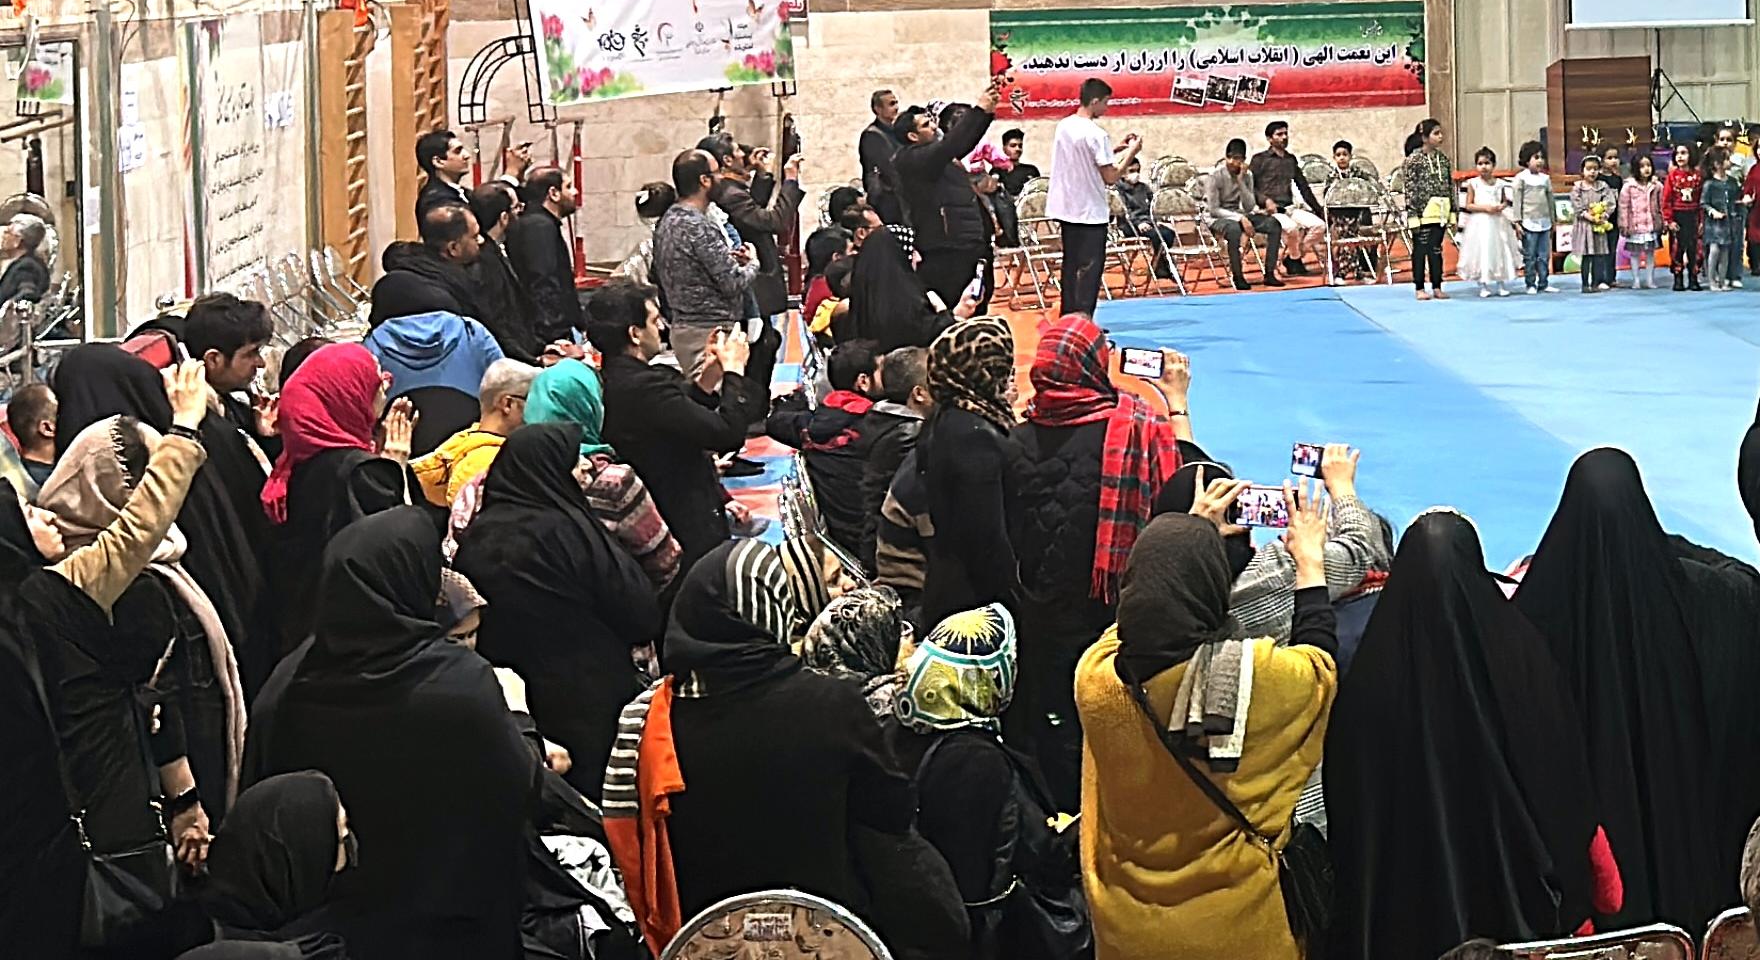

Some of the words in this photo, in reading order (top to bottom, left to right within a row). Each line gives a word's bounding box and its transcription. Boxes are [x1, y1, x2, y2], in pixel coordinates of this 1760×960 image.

[1072, 53, 1108, 69] دست
[1171, 49, 1186, 71] را
[1302, 44, 1333, 67] الهی
[1337, 47, 1371, 63] نعمت
[1374, 44, 1397, 65] این
